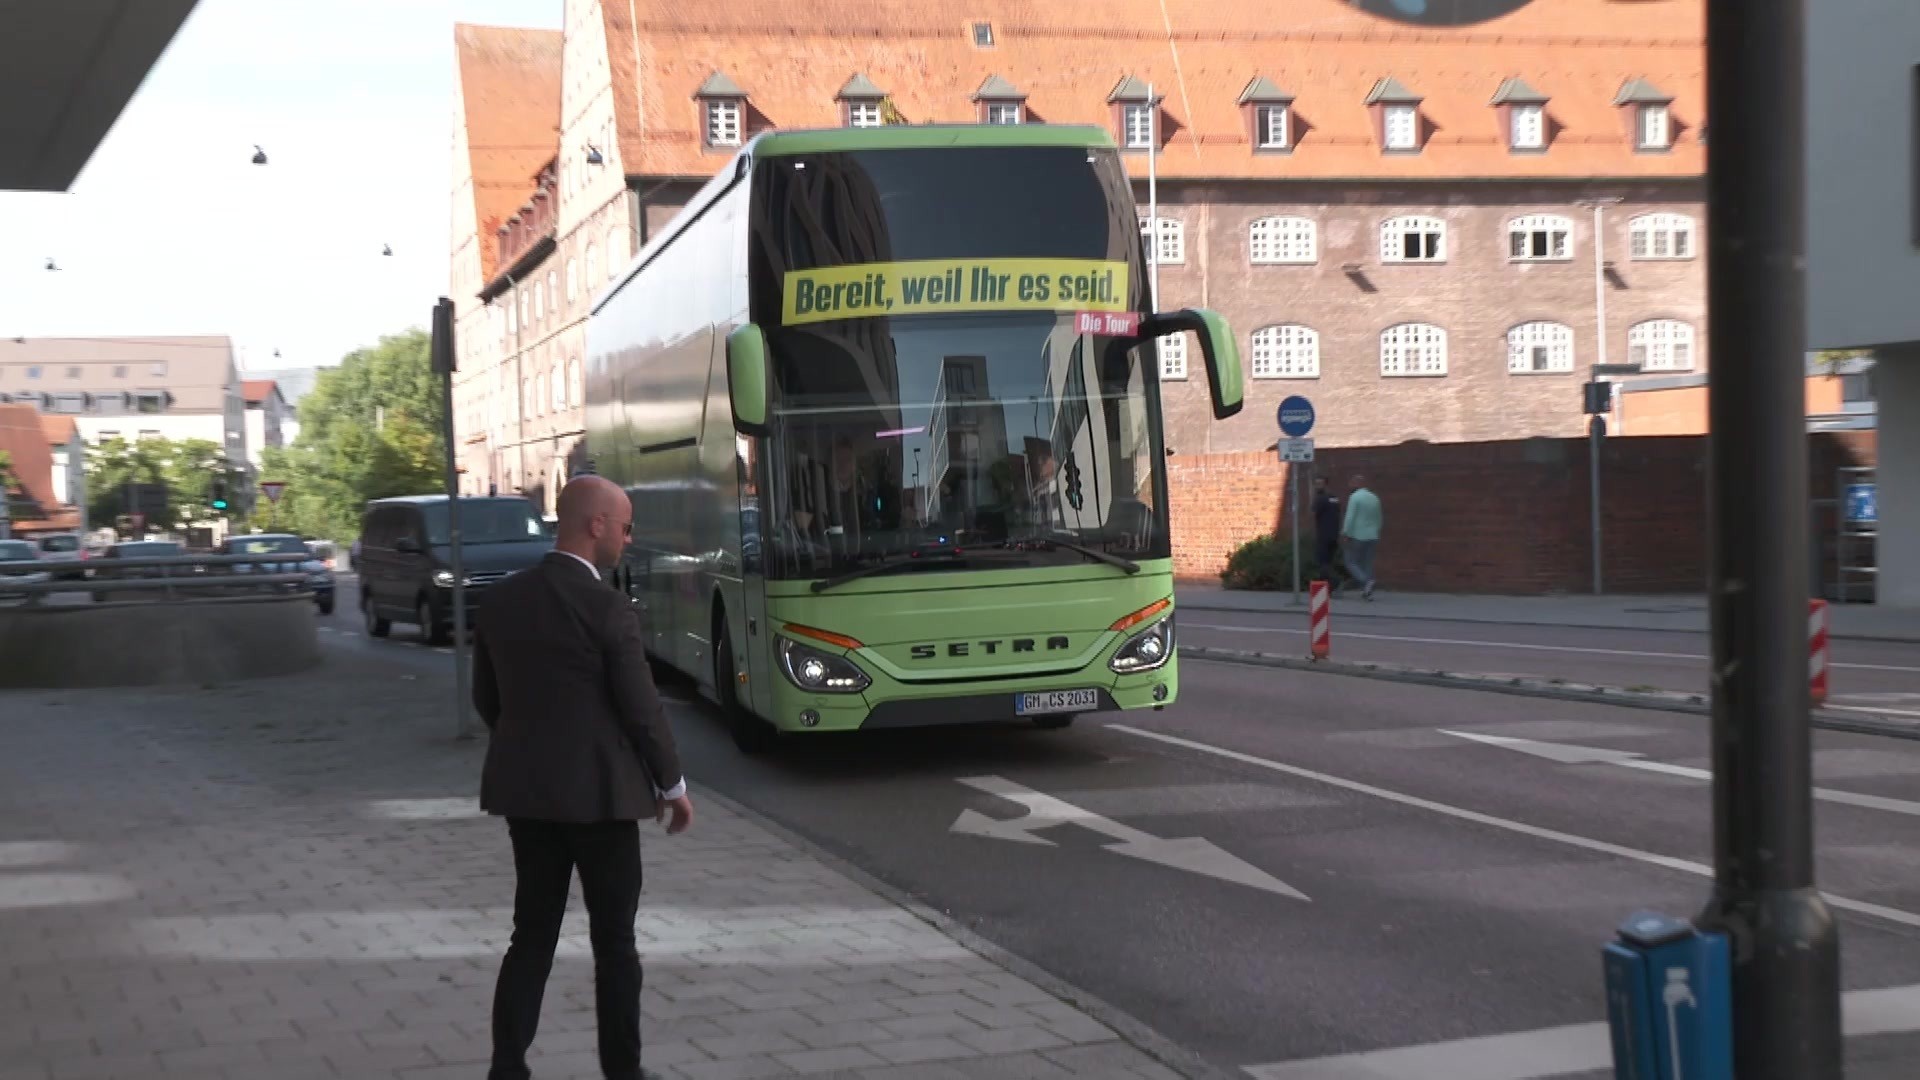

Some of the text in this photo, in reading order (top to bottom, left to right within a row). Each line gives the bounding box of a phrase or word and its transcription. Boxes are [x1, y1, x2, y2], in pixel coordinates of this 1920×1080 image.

[795, 267, 1120, 315] Bereit, weil Ihr es seid.
[1080, 313, 1131, 334] Die Tour
[910, 636, 1069, 659] SETRA
[1024, 690, 1096, 710] GM CS 2031
